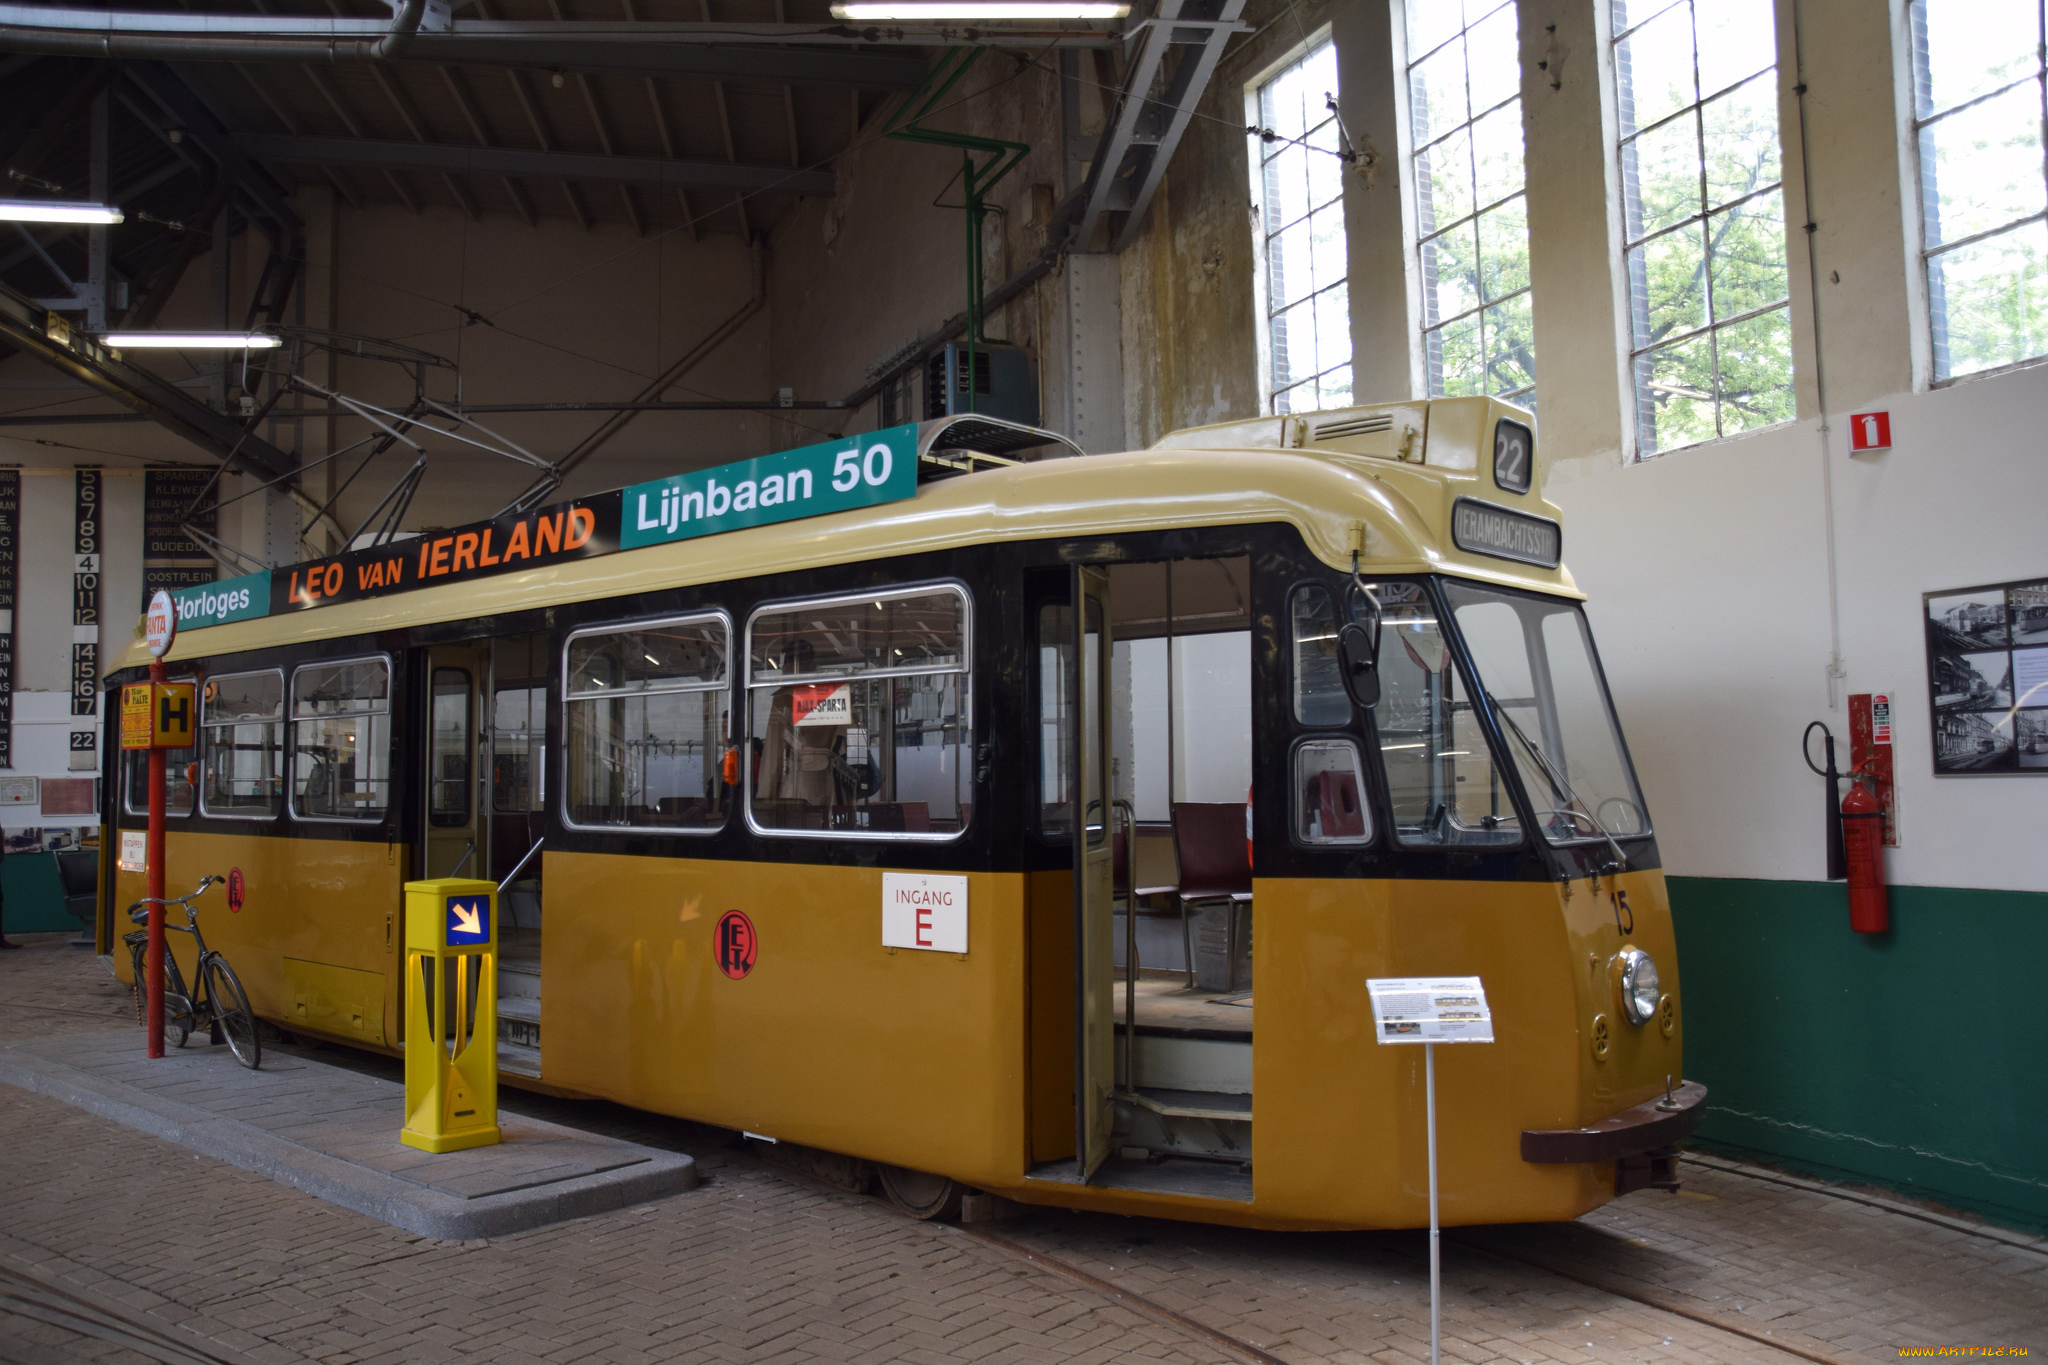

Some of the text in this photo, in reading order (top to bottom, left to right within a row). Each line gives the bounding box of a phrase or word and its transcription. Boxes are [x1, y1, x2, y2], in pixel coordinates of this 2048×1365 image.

[1495, 434, 1523, 483] 22
[81, 470, 96, 484] 5
[80, 486, 95, 501] 6
[637, 443, 894, 534] Lijnbaan 50
[80, 503, 96, 519] 7
[80, 521, 95, 536] 8
[80, 538, 95, 553] 9
[79, 556, 94, 571] 4
[288, 507, 596, 604] LEO VAN IERLAND
[76, 574, 97, 590] 10
[147, 572, 213, 582] OOSTPLEIN
[79, 591, 94, 607] 11
[174, 588, 250, 621] Horloges
[75, 609, 97, 625] 12
[74, 644, 95, 660] 14
[74, 661, 95, 678] 15
[74, 680, 94, 696] 16
[73, 698, 94, 714] 17
[161, 697, 188, 733] H
[72, 733, 94, 748] 22
[896, 889, 953, 906] INGANG
[1611, 890, 1634, 936] 15
[916, 908, 933, 947] E
